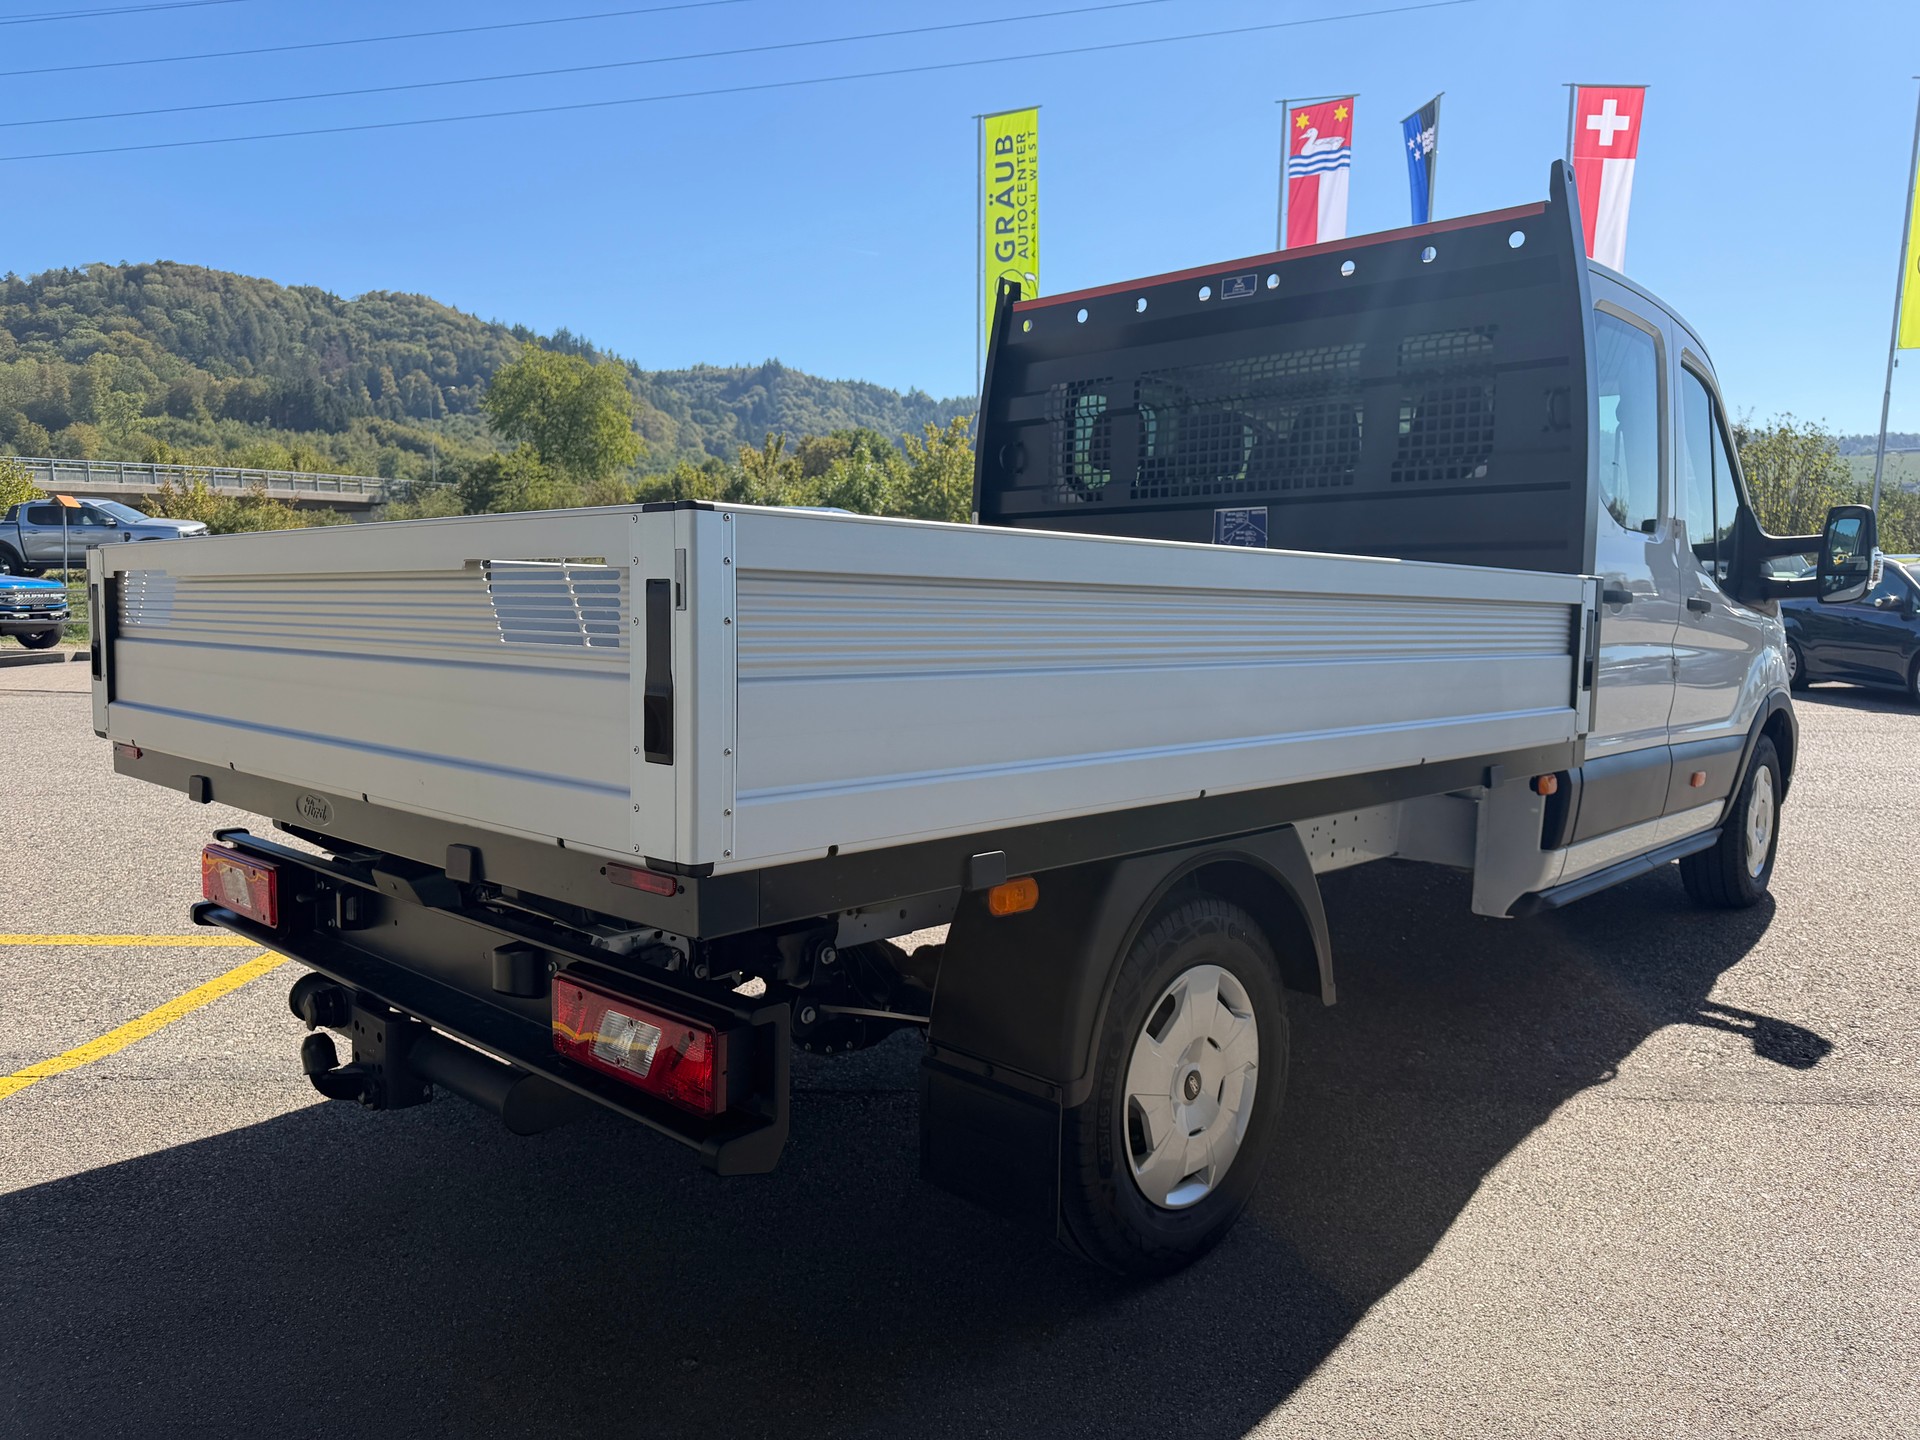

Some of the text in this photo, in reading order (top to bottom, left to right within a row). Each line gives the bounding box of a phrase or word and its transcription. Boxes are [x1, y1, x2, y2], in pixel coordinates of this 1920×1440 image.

[989, 135, 1015, 262] GRÄUB
[1016, 133, 1029, 259] AUTOCENTER
[1028, 131, 1037, 181] WEST
